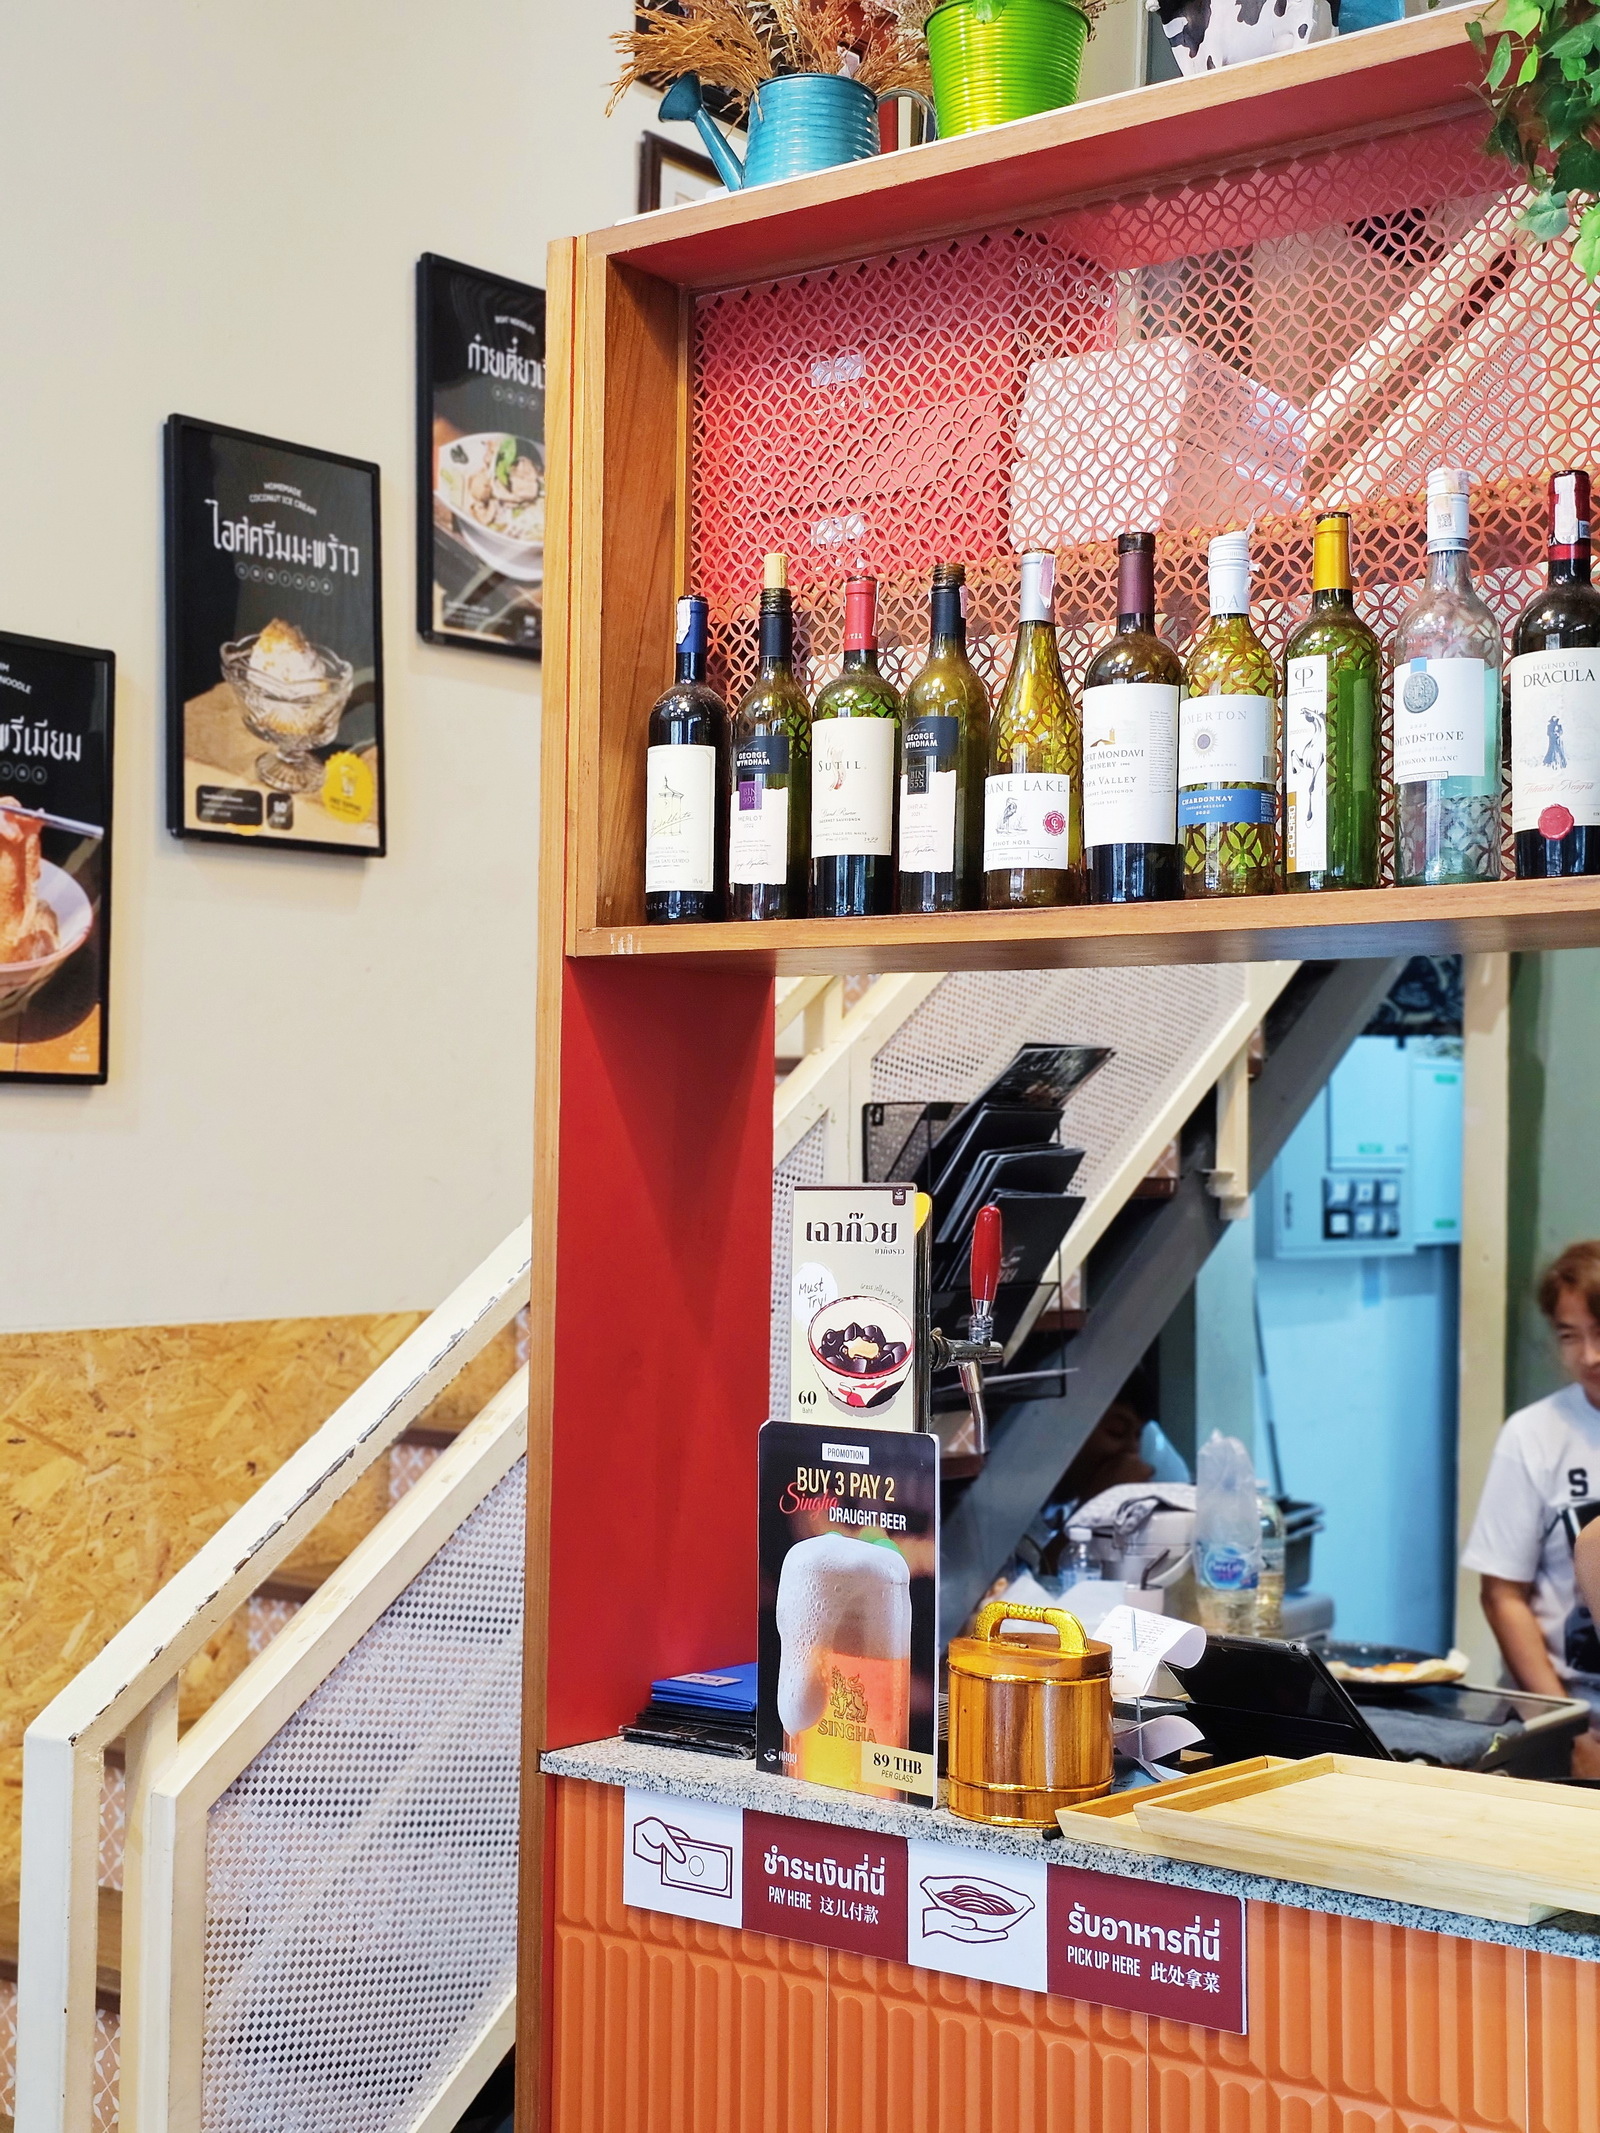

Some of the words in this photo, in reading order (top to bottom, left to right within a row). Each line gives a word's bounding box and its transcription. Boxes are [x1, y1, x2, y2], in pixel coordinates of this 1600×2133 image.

[1532, 662, 1565, 671] LEGEND
[1523, 668, 1596, 688] DRACULA
[906, 732, 935, 742] GEORGE
[905, 739, 938, 750] WYNDHAM
[738, 751, 767, 760] GEORGE
[1098, 749, 1144, 760] MONDAVI
[1429, 754, 1459, 763] BLANC
[736, 758, 771, 767] WYNDHAM
[818, 760, 861, 773] SUTIL
[1090, 761, 1117, 770] WINERY
[909, 770, 925, 780] BIN
[1098, 776, 1137, 786] VALLEY
[909, 779, 925, 789] 555
[1181, 795, 1233, 806] CHARDONNAY
[992, 840, 1009, 848] PINOT
[805, 1212, 898, 1244] เฉาก๊วย
[799, 1277, 824, 1295] Must
[798, 1390, 817, 1406] 60
[827, 1447, 864, 1460] PROMOTION
[797, 1466, 831, 1493] BUY
[835, 1471, 845, 1496] 3
[850, 1473, 880, 1499] PAY
[885, 1477, 895, 1502] 2
[779, 1482, 839, 1521] Singha
[829, 1506, 878, 1527] DRAUGHT
[880, 1513, 907, 1531] BEER
[818, 1719, 877, 1743] SINGHA
[873, 1752, 890, 1767] 89
[893, 1757, 922, 1775] THB
[881, 1769, 893, 1779] PER
[894, 1772, 914, 1784] GLASS
[763, 1845, 886, 1896] ชำระเงินที่นี่
[768, 1886, 786, 1906] PAY
[787, 1890, 812, 1910] HERE
[819, 1895, 879, 1925] 这儿付款
[1067, 1902, 1220, 1962] รับอาหารที่นี่
[1067, 1945, 1093, 1969] PICK
[1094, 1951, 1110, 1971] UP
[1112, 1954, 1141, 1977] HERE
[1150, 1962, 1221, 1993] 此处拿菜
